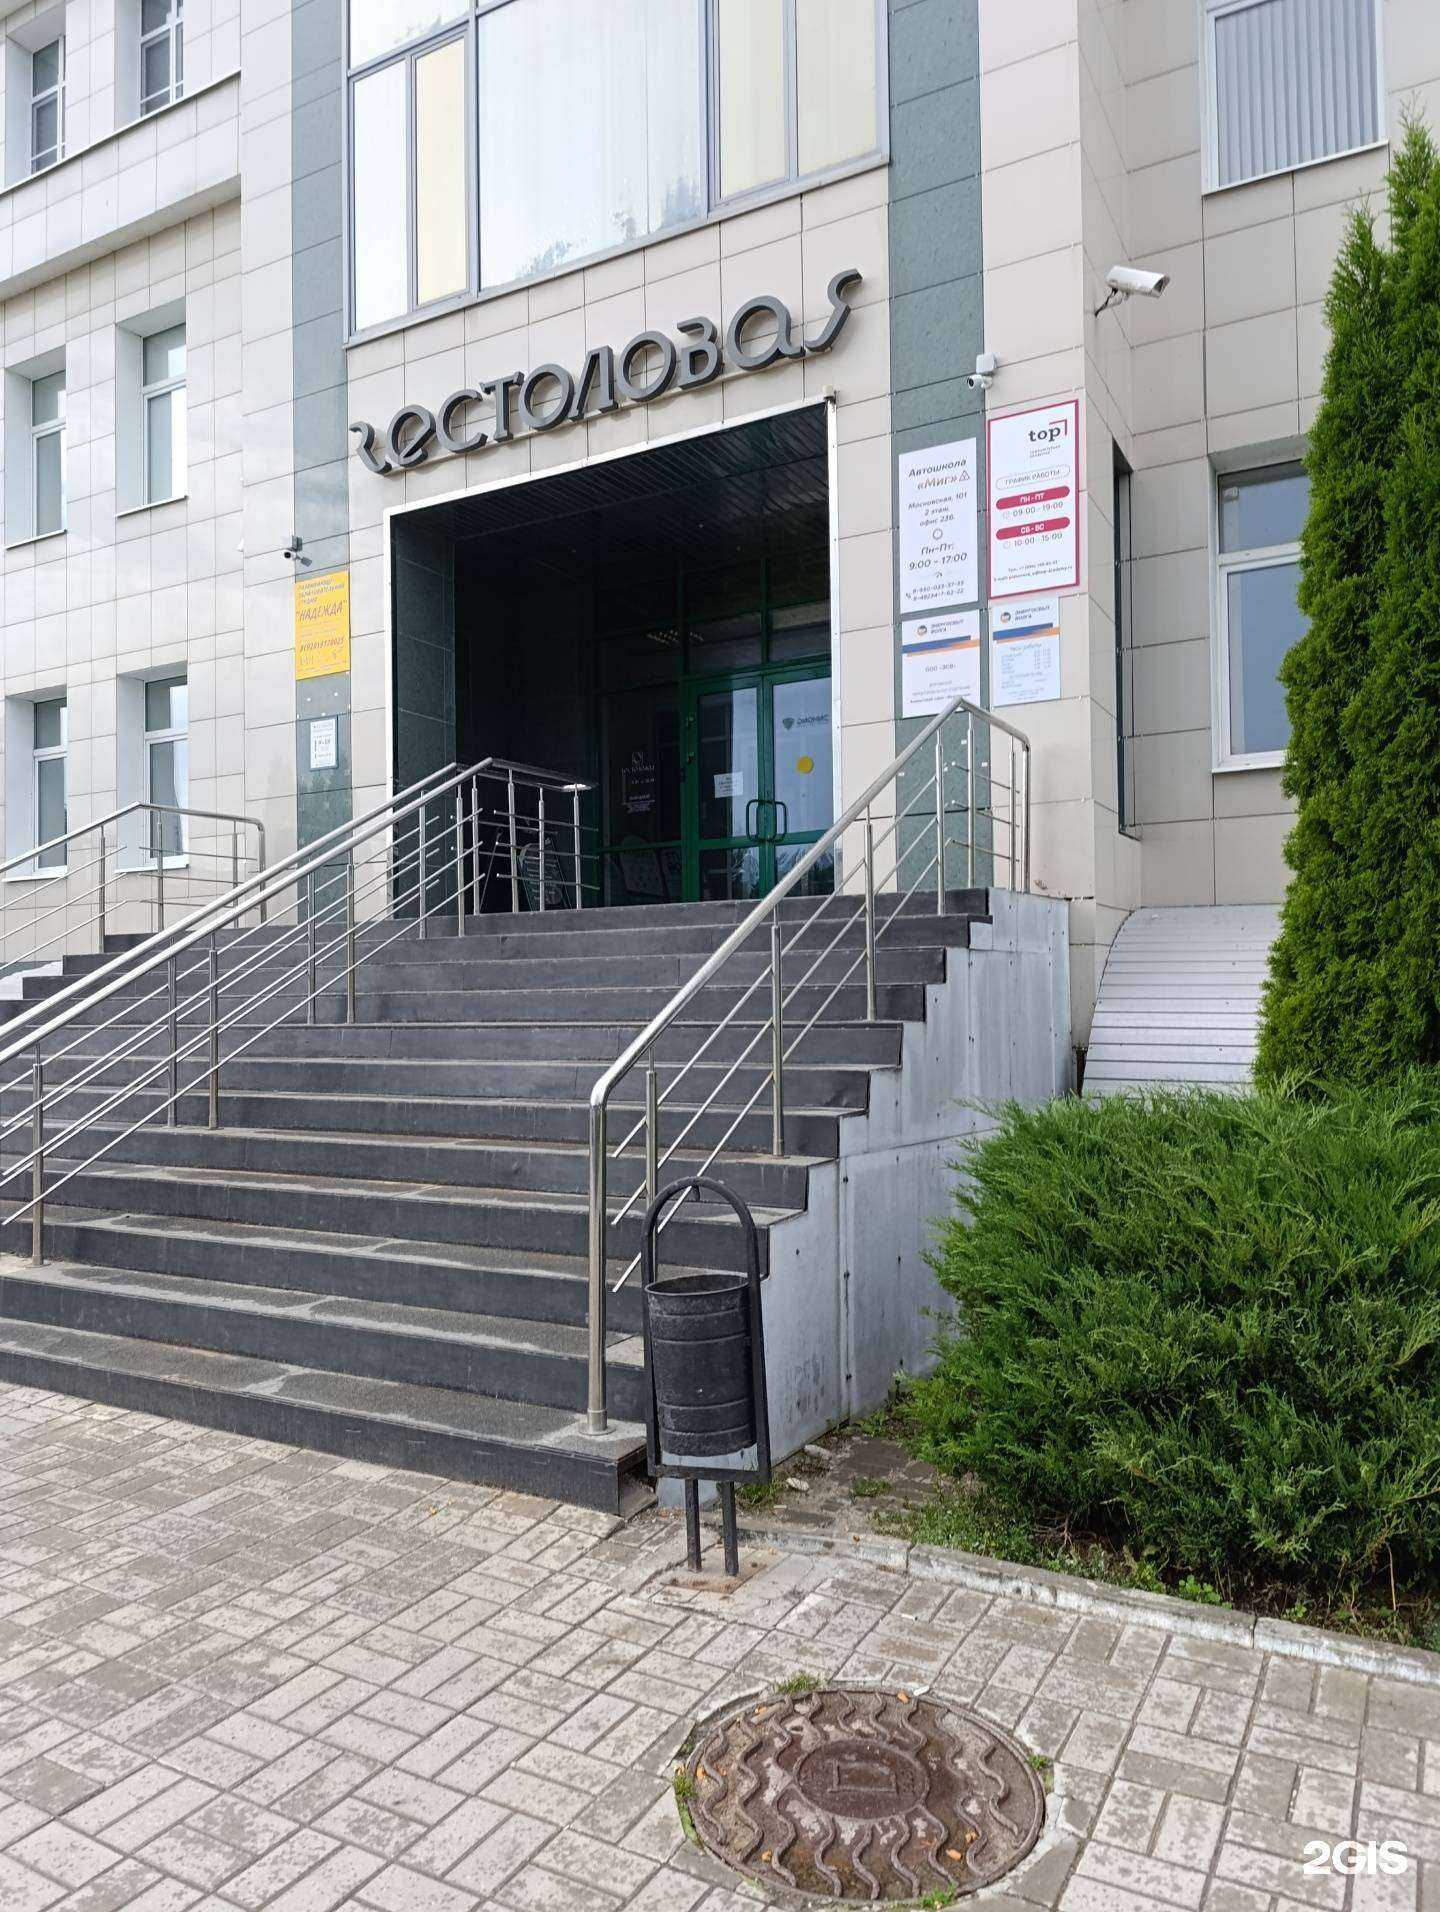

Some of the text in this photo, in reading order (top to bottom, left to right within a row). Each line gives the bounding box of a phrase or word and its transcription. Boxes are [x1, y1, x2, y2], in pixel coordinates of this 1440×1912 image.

[1028, 426, 1061, 443] top
[908, 458, 967, 478] Автошкола
[1031, 469, 1060, 480] РАБОТЫ
[941, 552, 968, 565] 17:00
